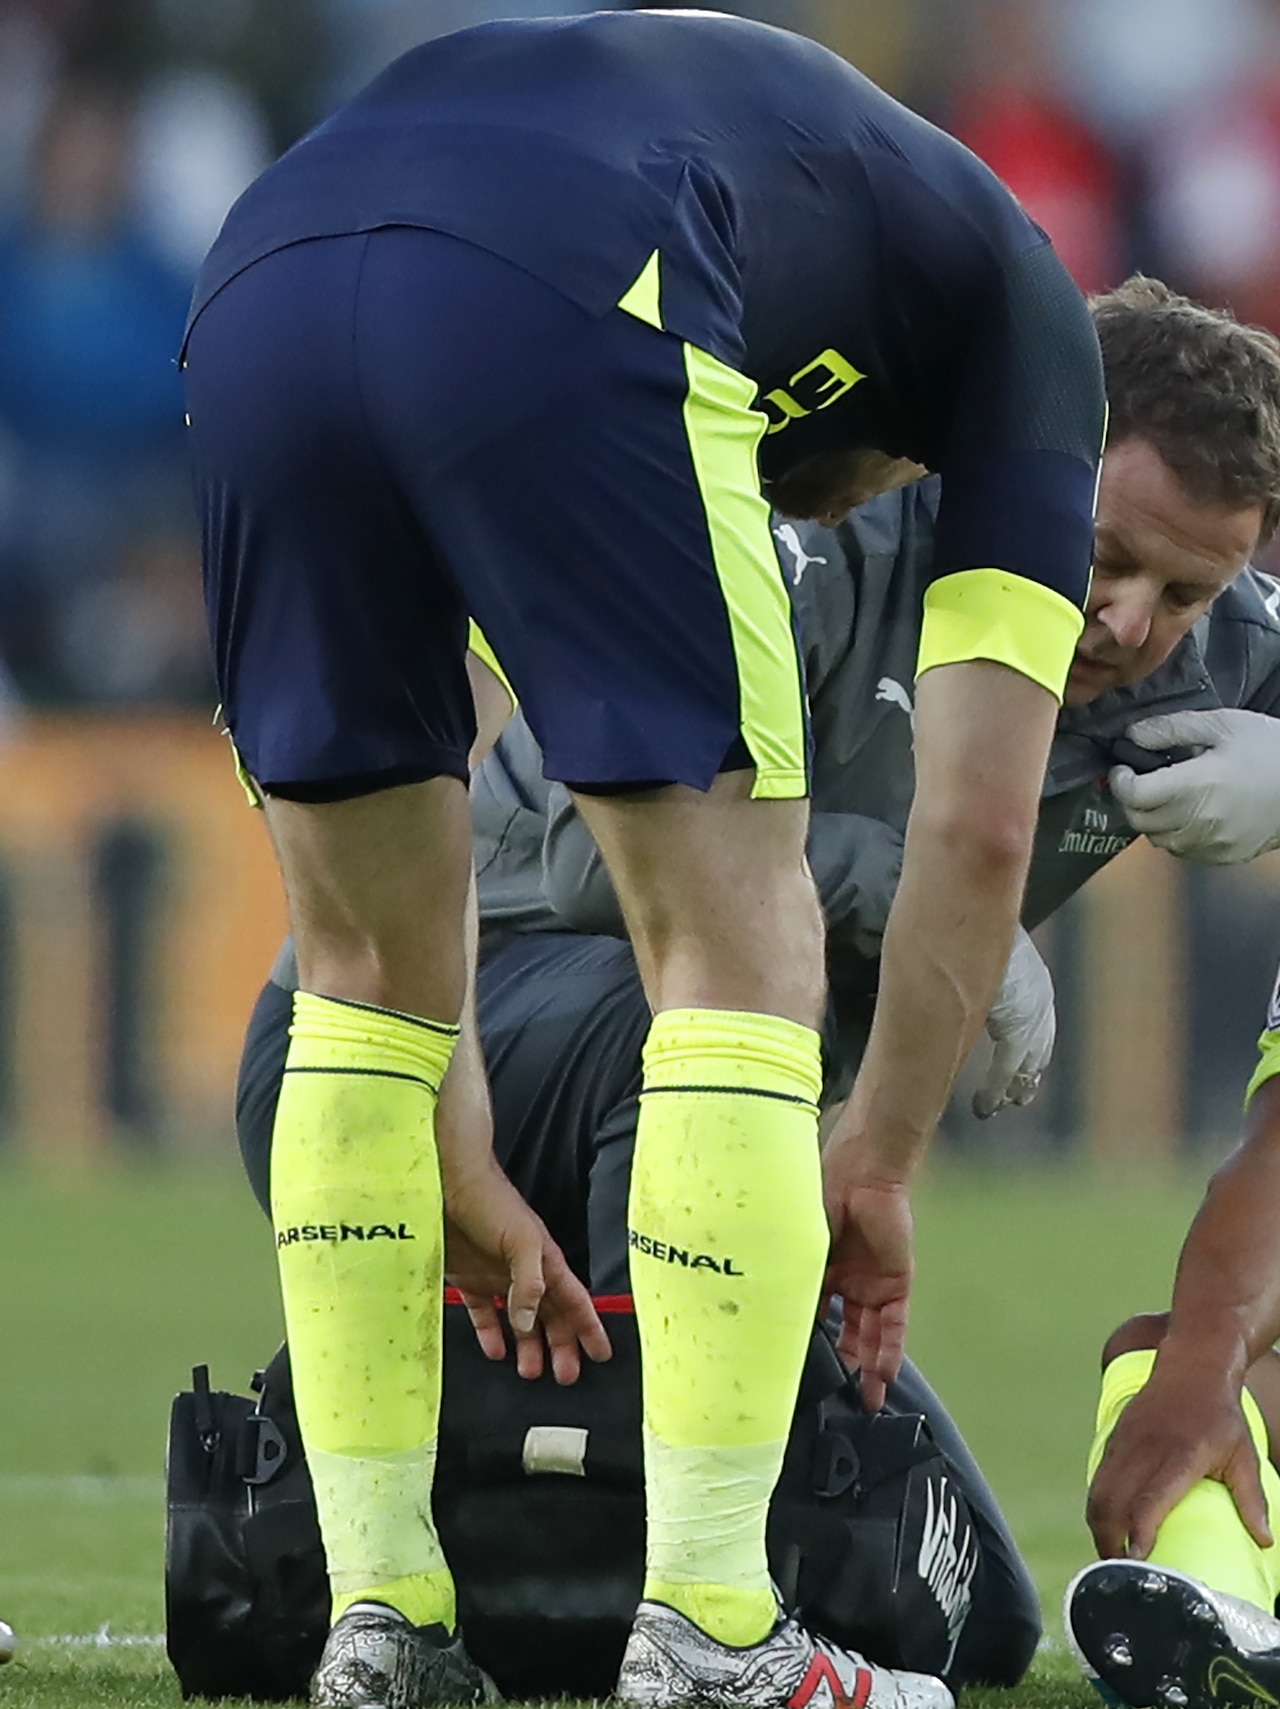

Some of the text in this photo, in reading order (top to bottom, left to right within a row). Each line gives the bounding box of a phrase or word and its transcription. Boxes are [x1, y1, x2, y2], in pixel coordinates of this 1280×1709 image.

[1084, 808, 1108, 832] Fly
[277, 1222, 416, 1250] ARSENAL
[628, 1229, 745, 1277] RSENAL
